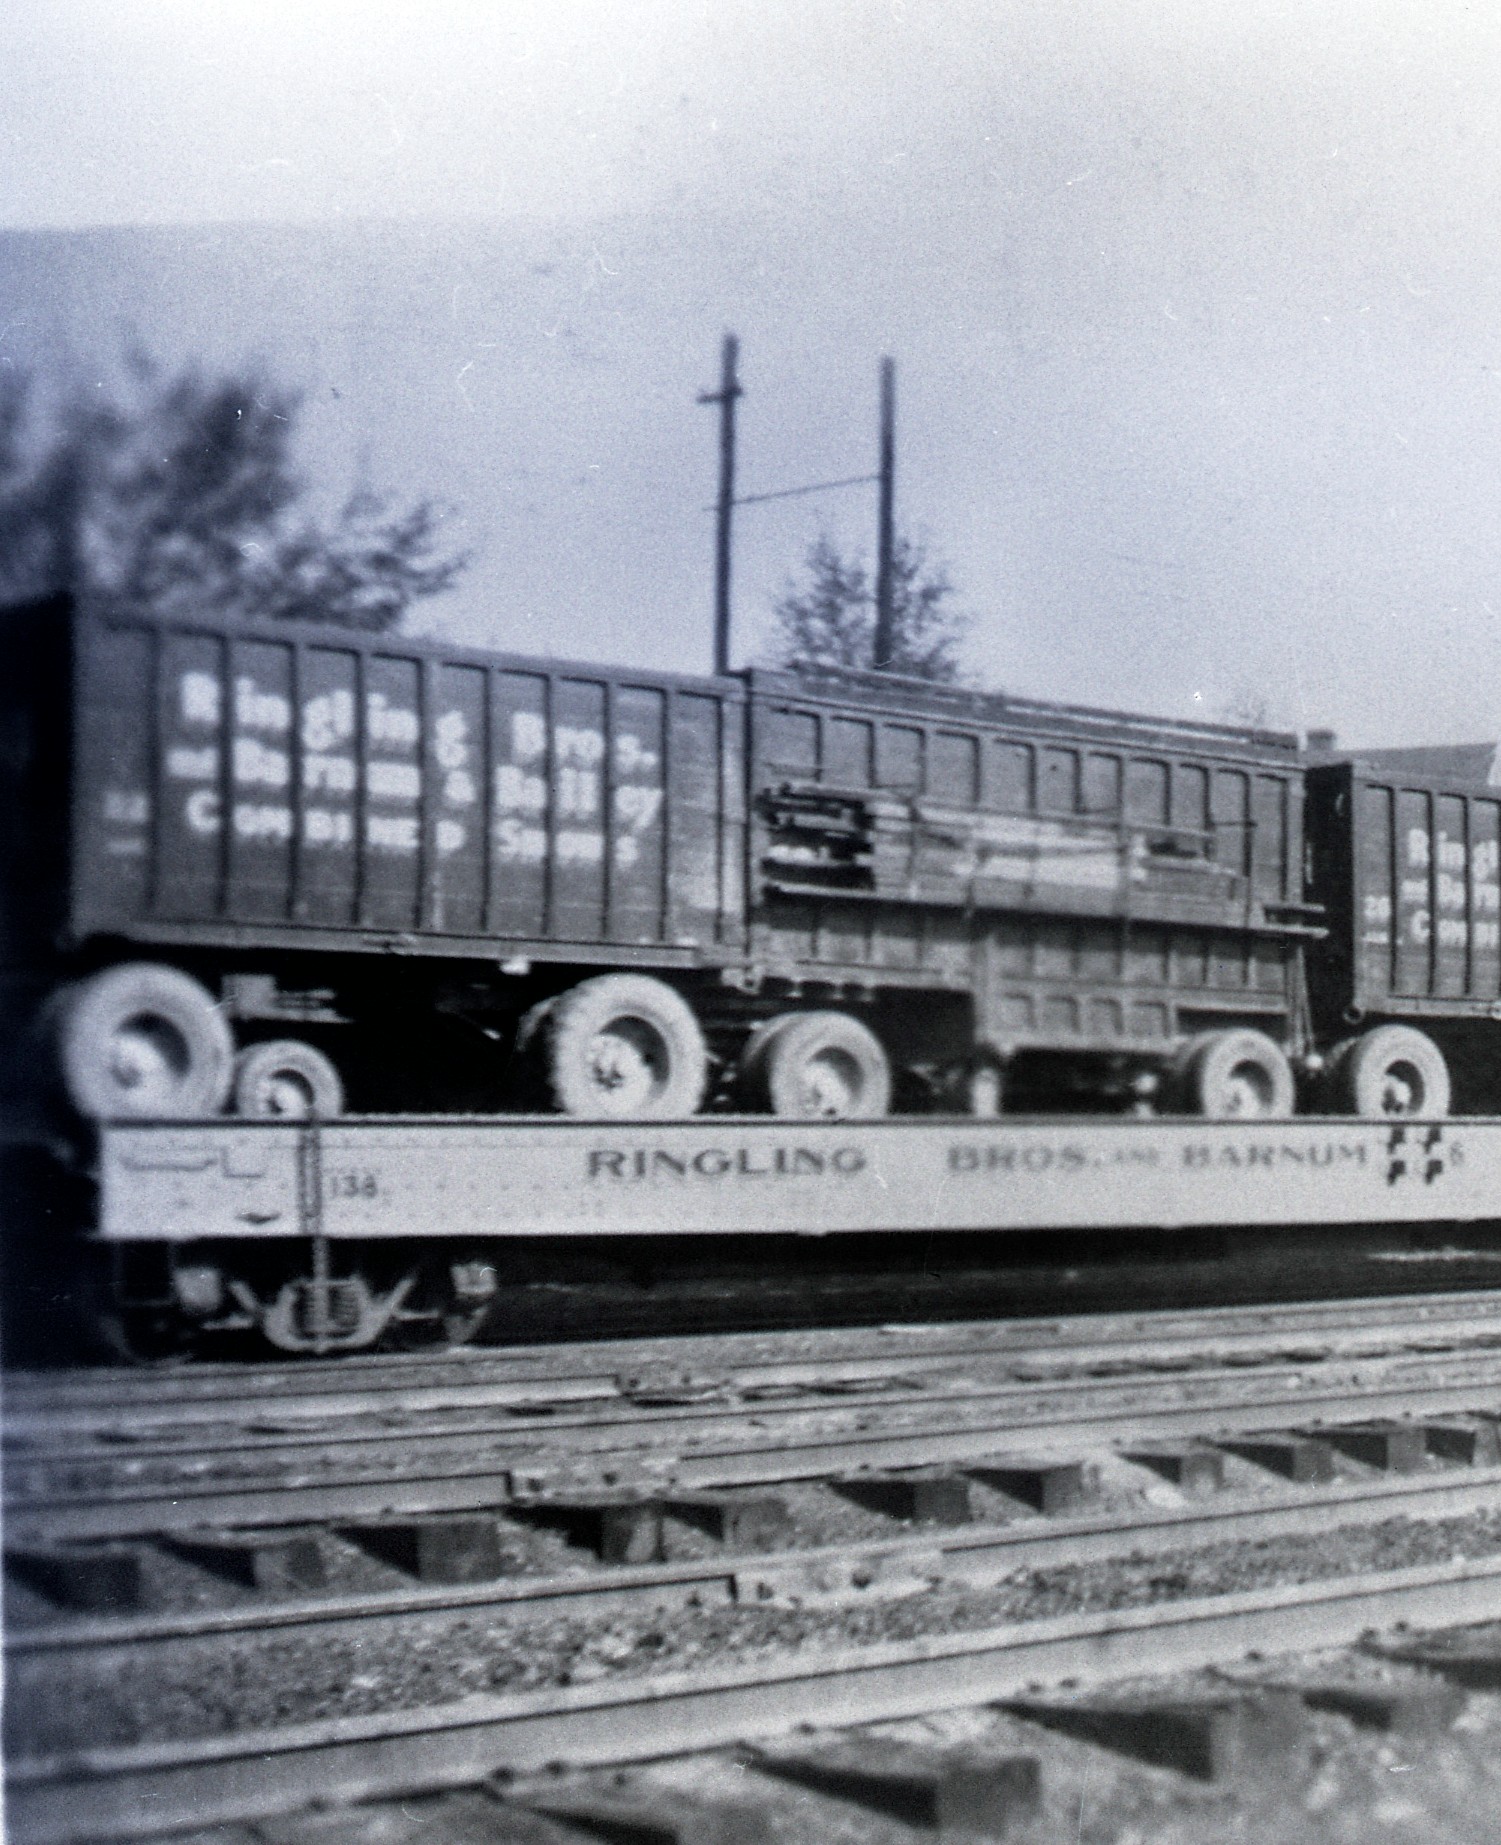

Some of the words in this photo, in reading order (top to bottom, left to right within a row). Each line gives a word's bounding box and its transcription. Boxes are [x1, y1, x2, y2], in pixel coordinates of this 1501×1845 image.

[586, 1147, 867, 1178] RINGLING
[947, 1144, 1102, 1172] BROS.
[1182, 1143, 1367, 1169] BARNUM
